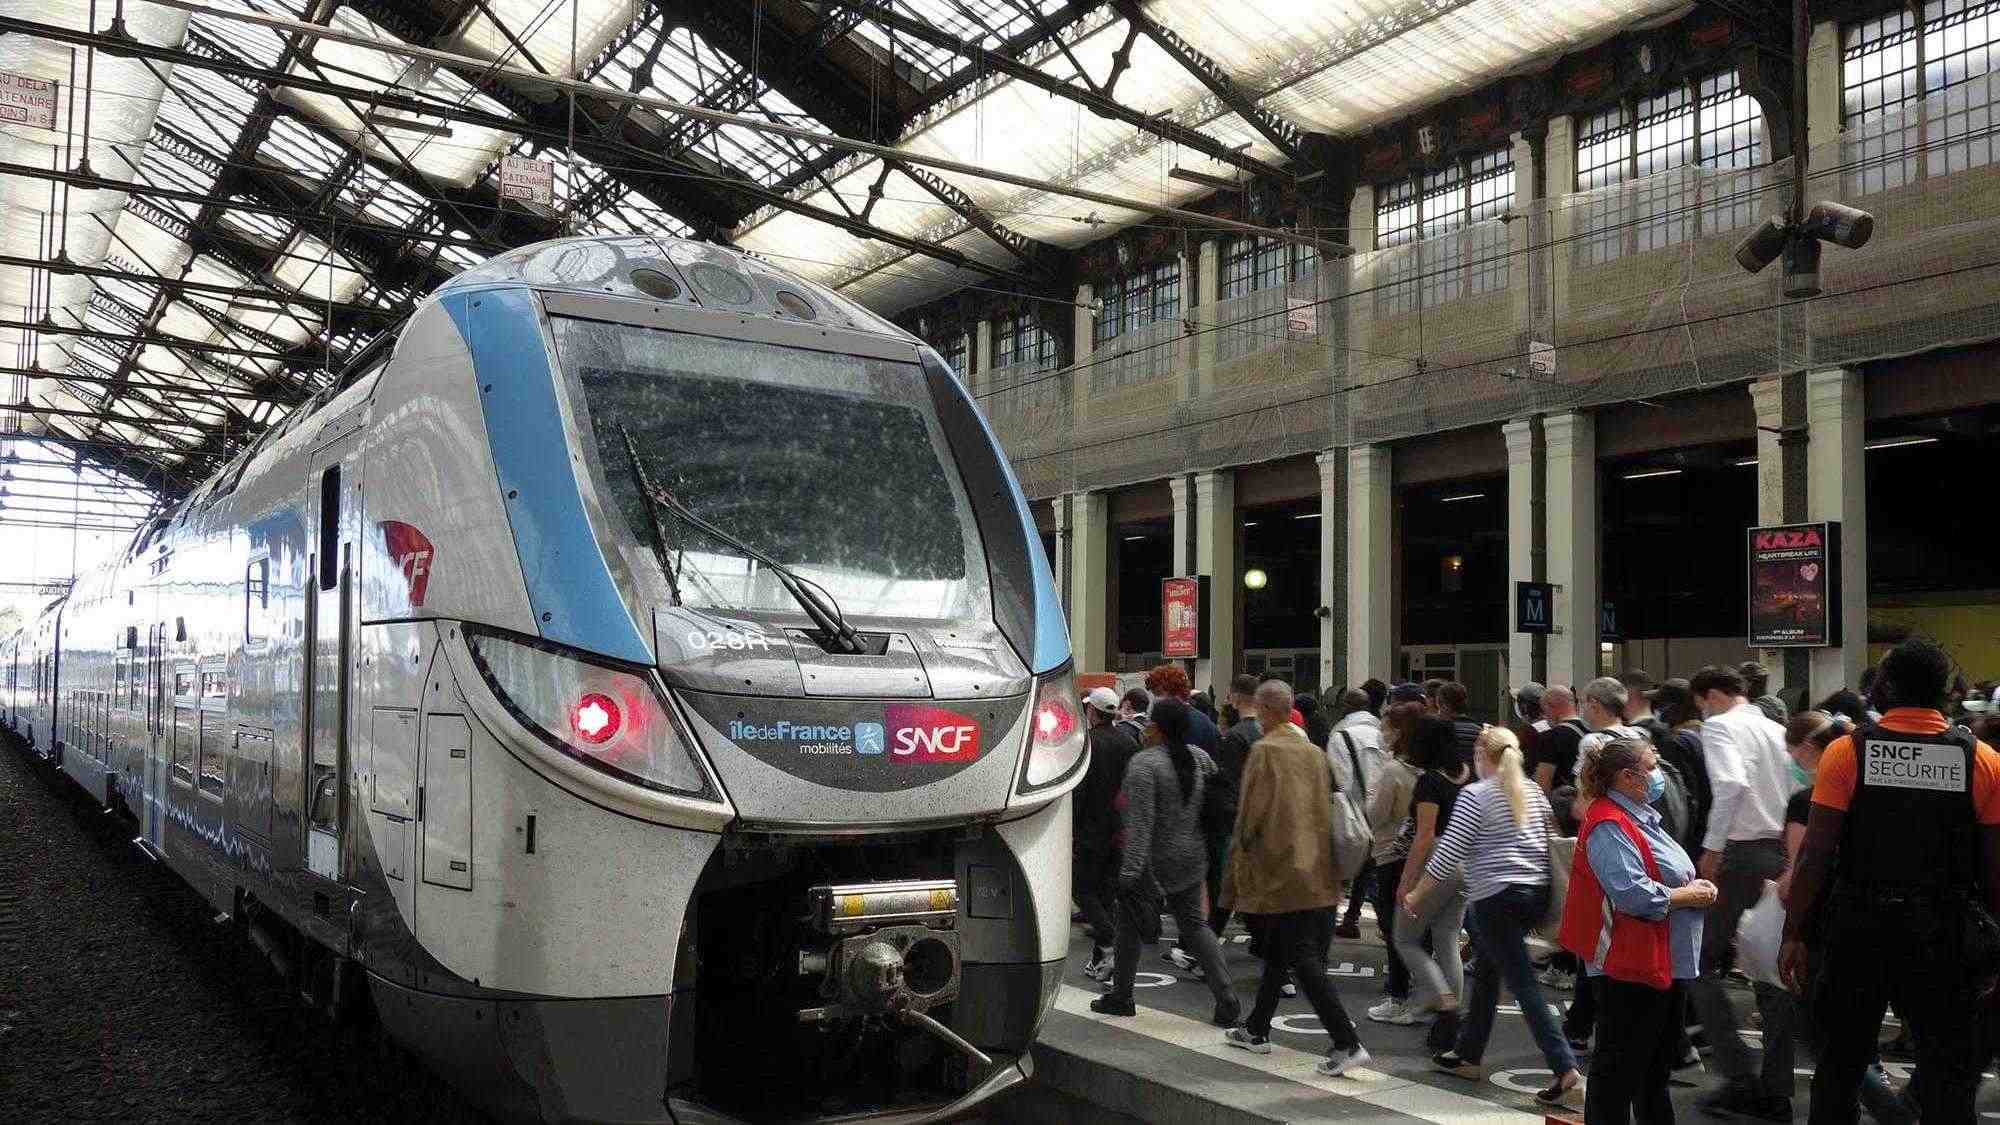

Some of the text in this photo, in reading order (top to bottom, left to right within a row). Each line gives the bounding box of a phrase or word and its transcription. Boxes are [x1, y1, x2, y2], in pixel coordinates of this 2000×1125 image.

[506, 159, 519, 169] AU
[503, 173, 551, 187] CATENAIRE
[505, 187, 531, 198] MOINS
[1755, 530, 1821, 549] KAZA
[1758, 551, 1803, 560] HEARTBREAK
[1526, 597, 1544, 621] M
[894, 725, 976, 755] SNCF
[800, 741, 852, 755] mobilités
[1870, 744, 1923, 760] SNCF
